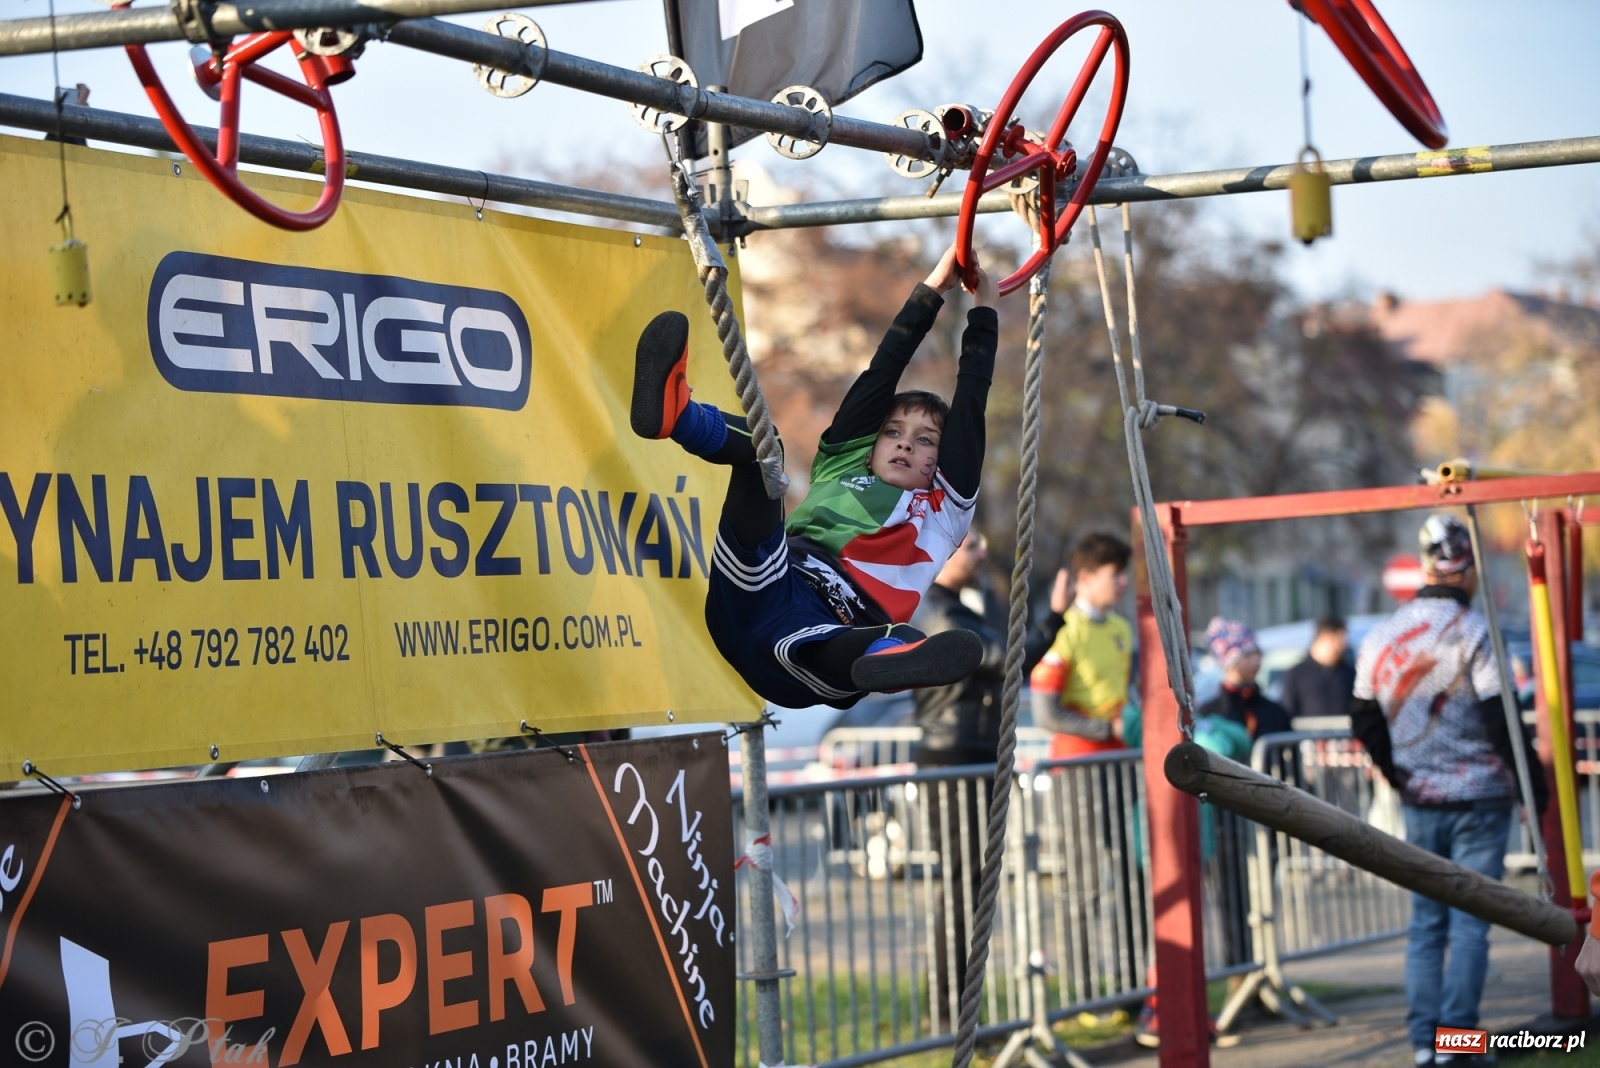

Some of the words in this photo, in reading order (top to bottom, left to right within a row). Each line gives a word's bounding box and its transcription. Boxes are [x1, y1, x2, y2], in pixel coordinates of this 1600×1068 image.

[159, 272, 522, 392] ERIGO
[0, 472, 315, 584] YNAJEM
[336, 475, 709, 580] RUSZTOWAŃ
[63, 633, 125, 675] TEL.
[133, 629, 183, 670] +48
[190, 628, 241, 668] 792
[247, 625, 297, 665] 782
[303, 624, 350, 662] 402
[394, 615, 642, 657] WWW.ERIGO.COM.PL
[614, 762, 715, 1029] Machine
[205, 882, 592, 1068] EXPERT
[506, 1025, 594, 1068] BRAMY
